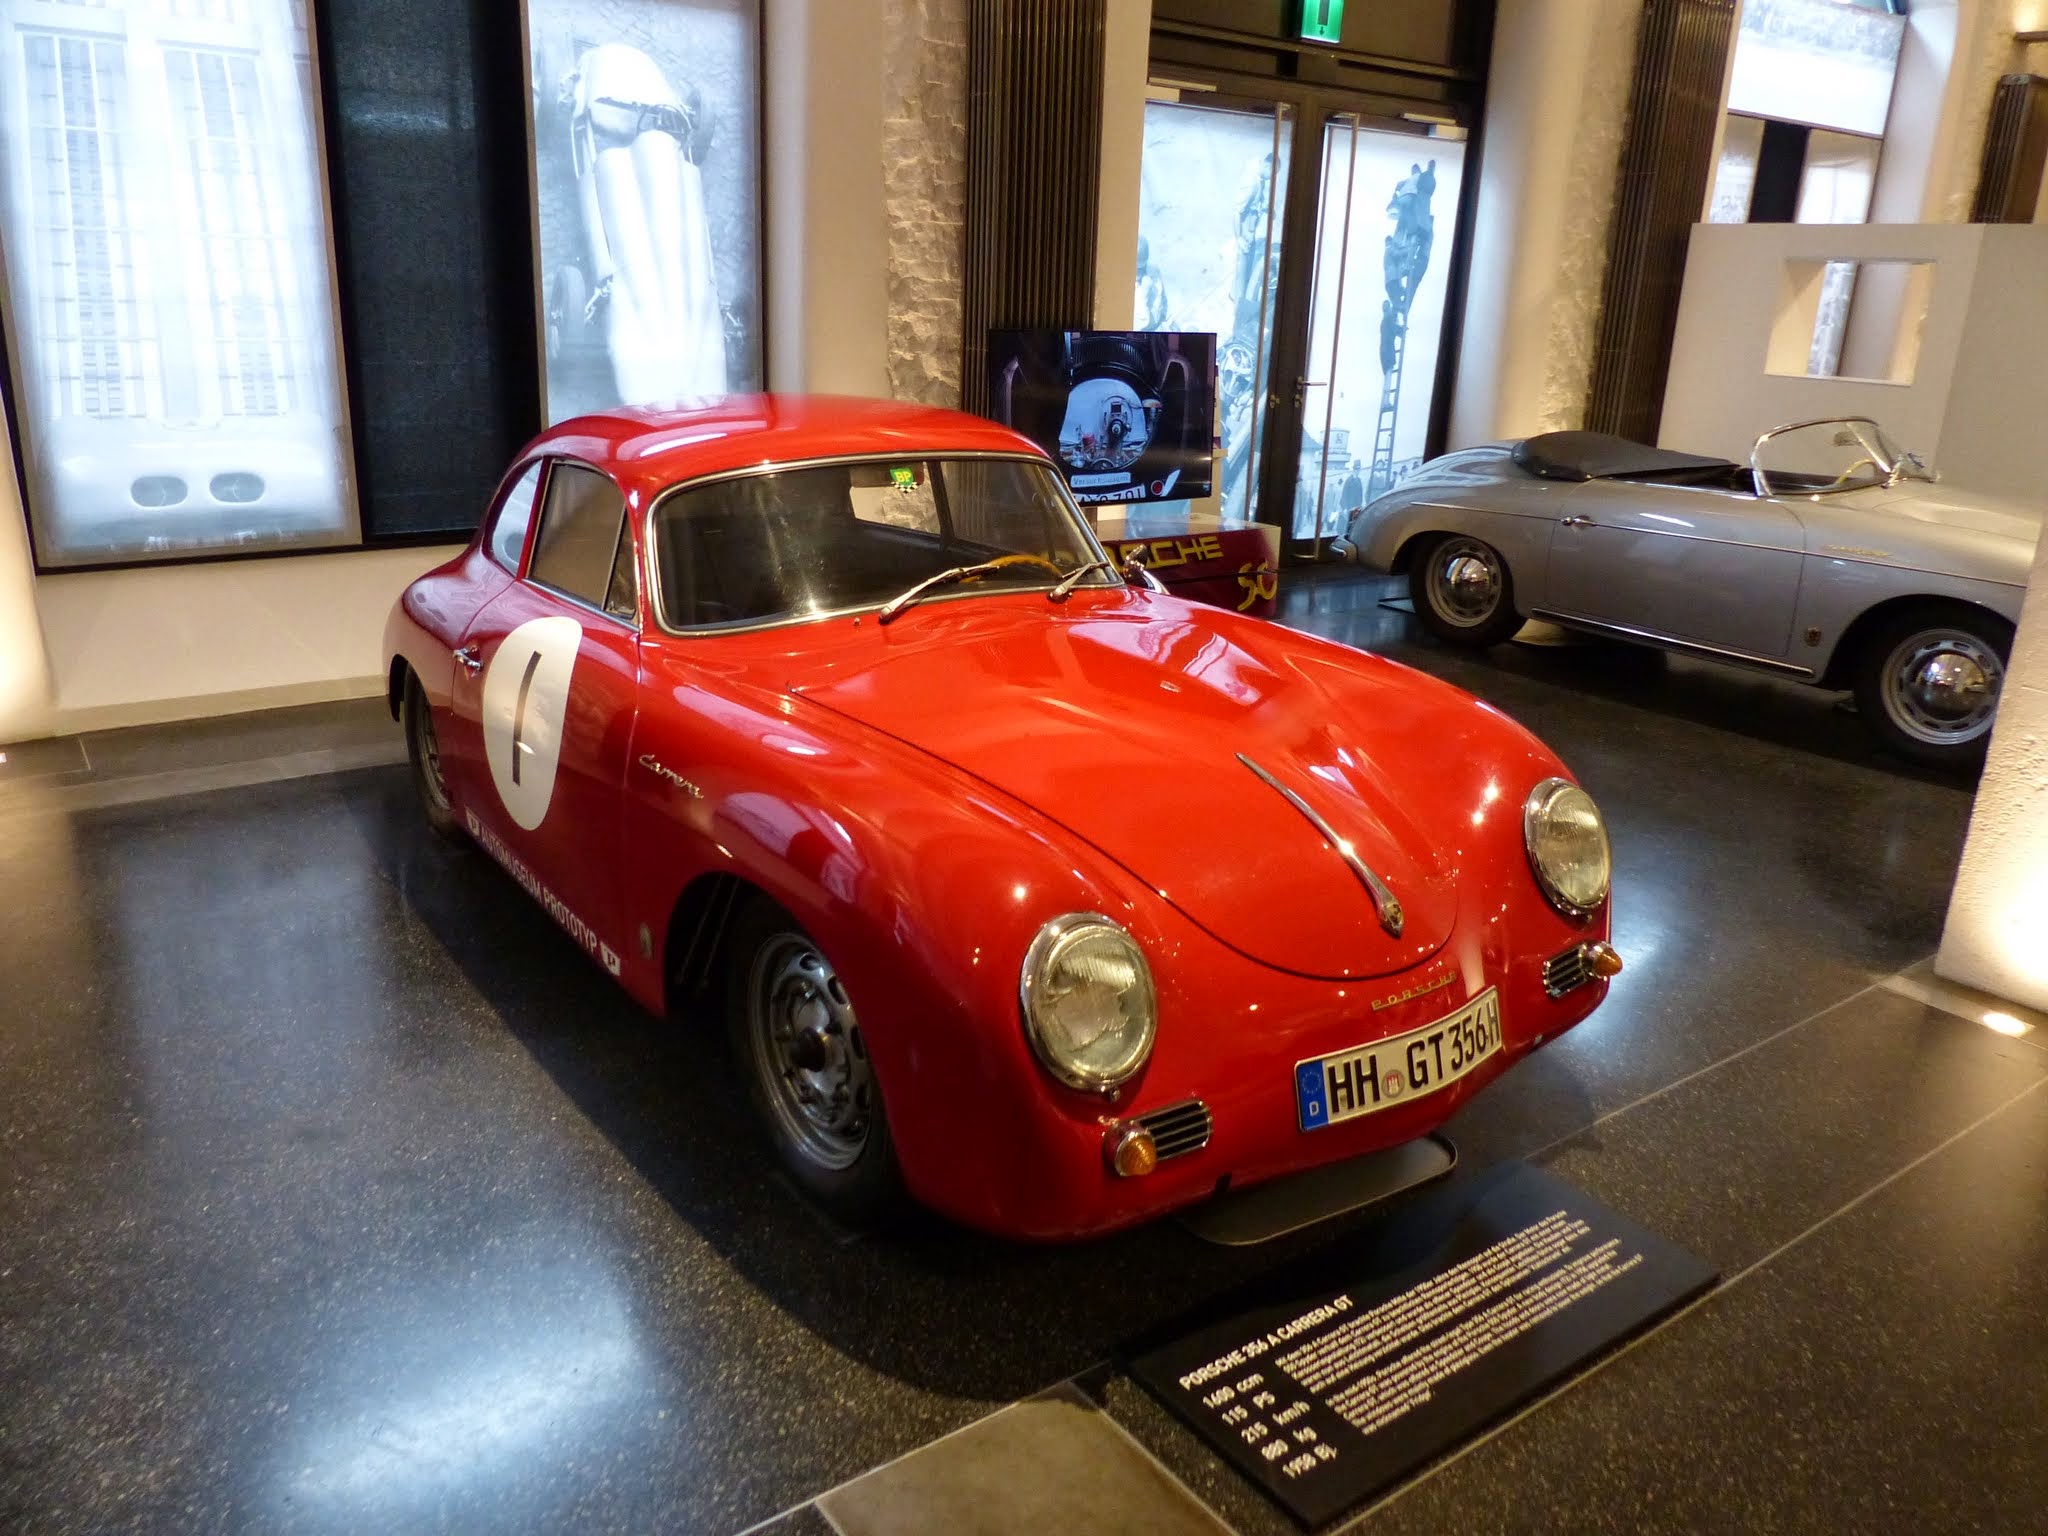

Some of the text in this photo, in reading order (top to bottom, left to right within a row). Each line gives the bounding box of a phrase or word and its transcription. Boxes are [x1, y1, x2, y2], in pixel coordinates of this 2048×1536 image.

[894, 471, 912, 482] BP
[512, 651, 542, 787] 1
[639, 754, 704, 799] Carrera
[481, 826, 598, 953] AUTOMUSEUM PROTOTYP
[1371, 972, 1456, 1011] PORSCHE
[1309, 997, 1500, 1116] D HH GT 356H
[1179, 1294, 1354, 1391] PORSCHE 356 A CARRERA GT
[1202, 1373, 1264, 1409] 1600 ccm
[1222, 1390, 1275, 1425] 115 PS
[1241, 1400, 1310, 1444] 215 km/h
[1293, 1426, 1317, 1443] kg
[1282, 1452, 1316, 1479] 1958
